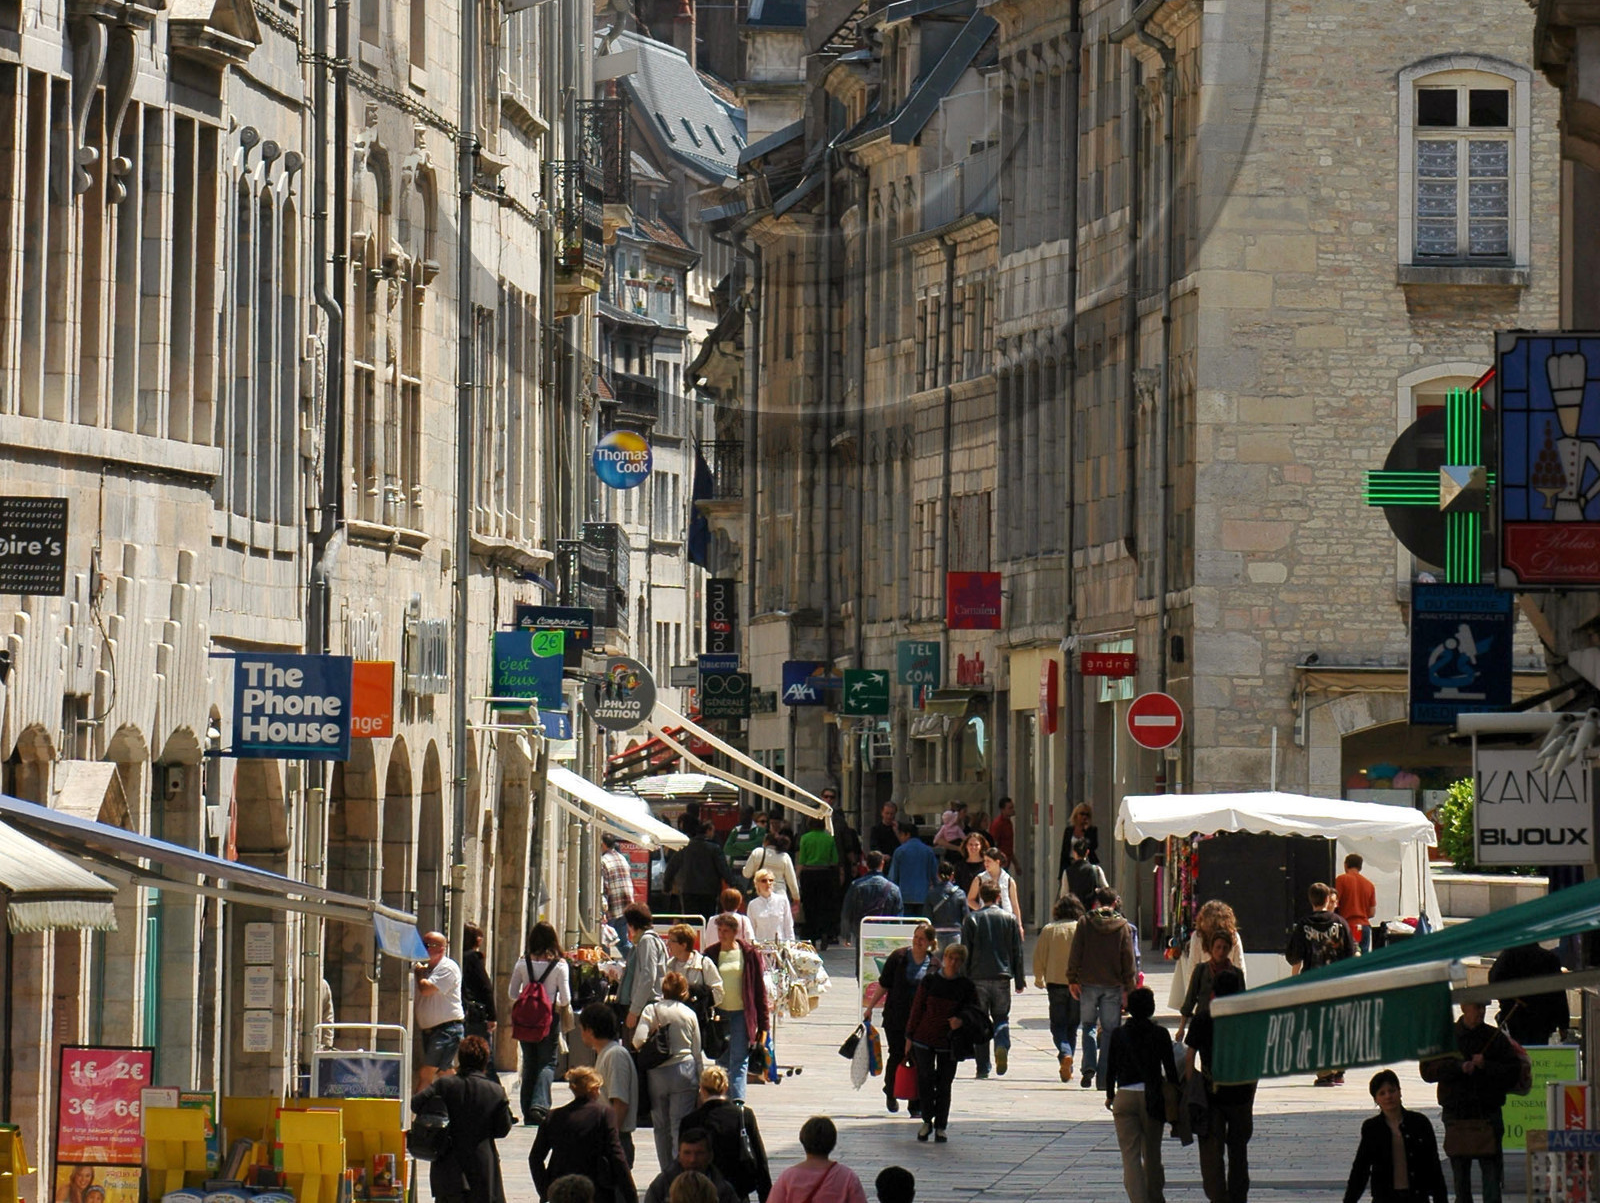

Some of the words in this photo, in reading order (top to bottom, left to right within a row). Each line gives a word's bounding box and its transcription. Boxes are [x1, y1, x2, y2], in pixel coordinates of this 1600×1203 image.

[596, 448, 648, 461] Thomas
[616, 460, 648, 473] Cook
[3, 500, 63, 508] accessories
[2, 510, 63, 519] accessories
[2, 521, 62, 529] accessories
[1, 562, 61, 571] accessories
[0, 573, 60, 581] accessories
[0, 583, 60, 592] accessories
[537, 634, 559, 651] 2€
[908, 644, 932, 655] TEL
[499, 656, 532, 672] c'est
[242, 661, 304, 688] The
[499, 672, 539, 686] deux
[905, 670, 934, 682] COM
[783, 683, 816, 699] AXA
[242, 689, 342, 716] Phone
[604, 699, 641, 710] PHOTO
[594, 709, 641, 719] STATION
[242, 716, 341, 744] House
[1480, 828, 1589, 845] BIJOUX
[1263, 1013, 1296, 1075] PUB
[1296, 1009, 1312, 1068] de
[1317, 998, 1384, 1067] L'ETOILE
[70, 1060, 97, 1078] 1€
[116, 1062, 144, 1080] 2€
[68, 1098, 95, 1115] 3€
[114, 1100, 140, 1117] 6€
[1506, 1125, 1523, 1138] 10
